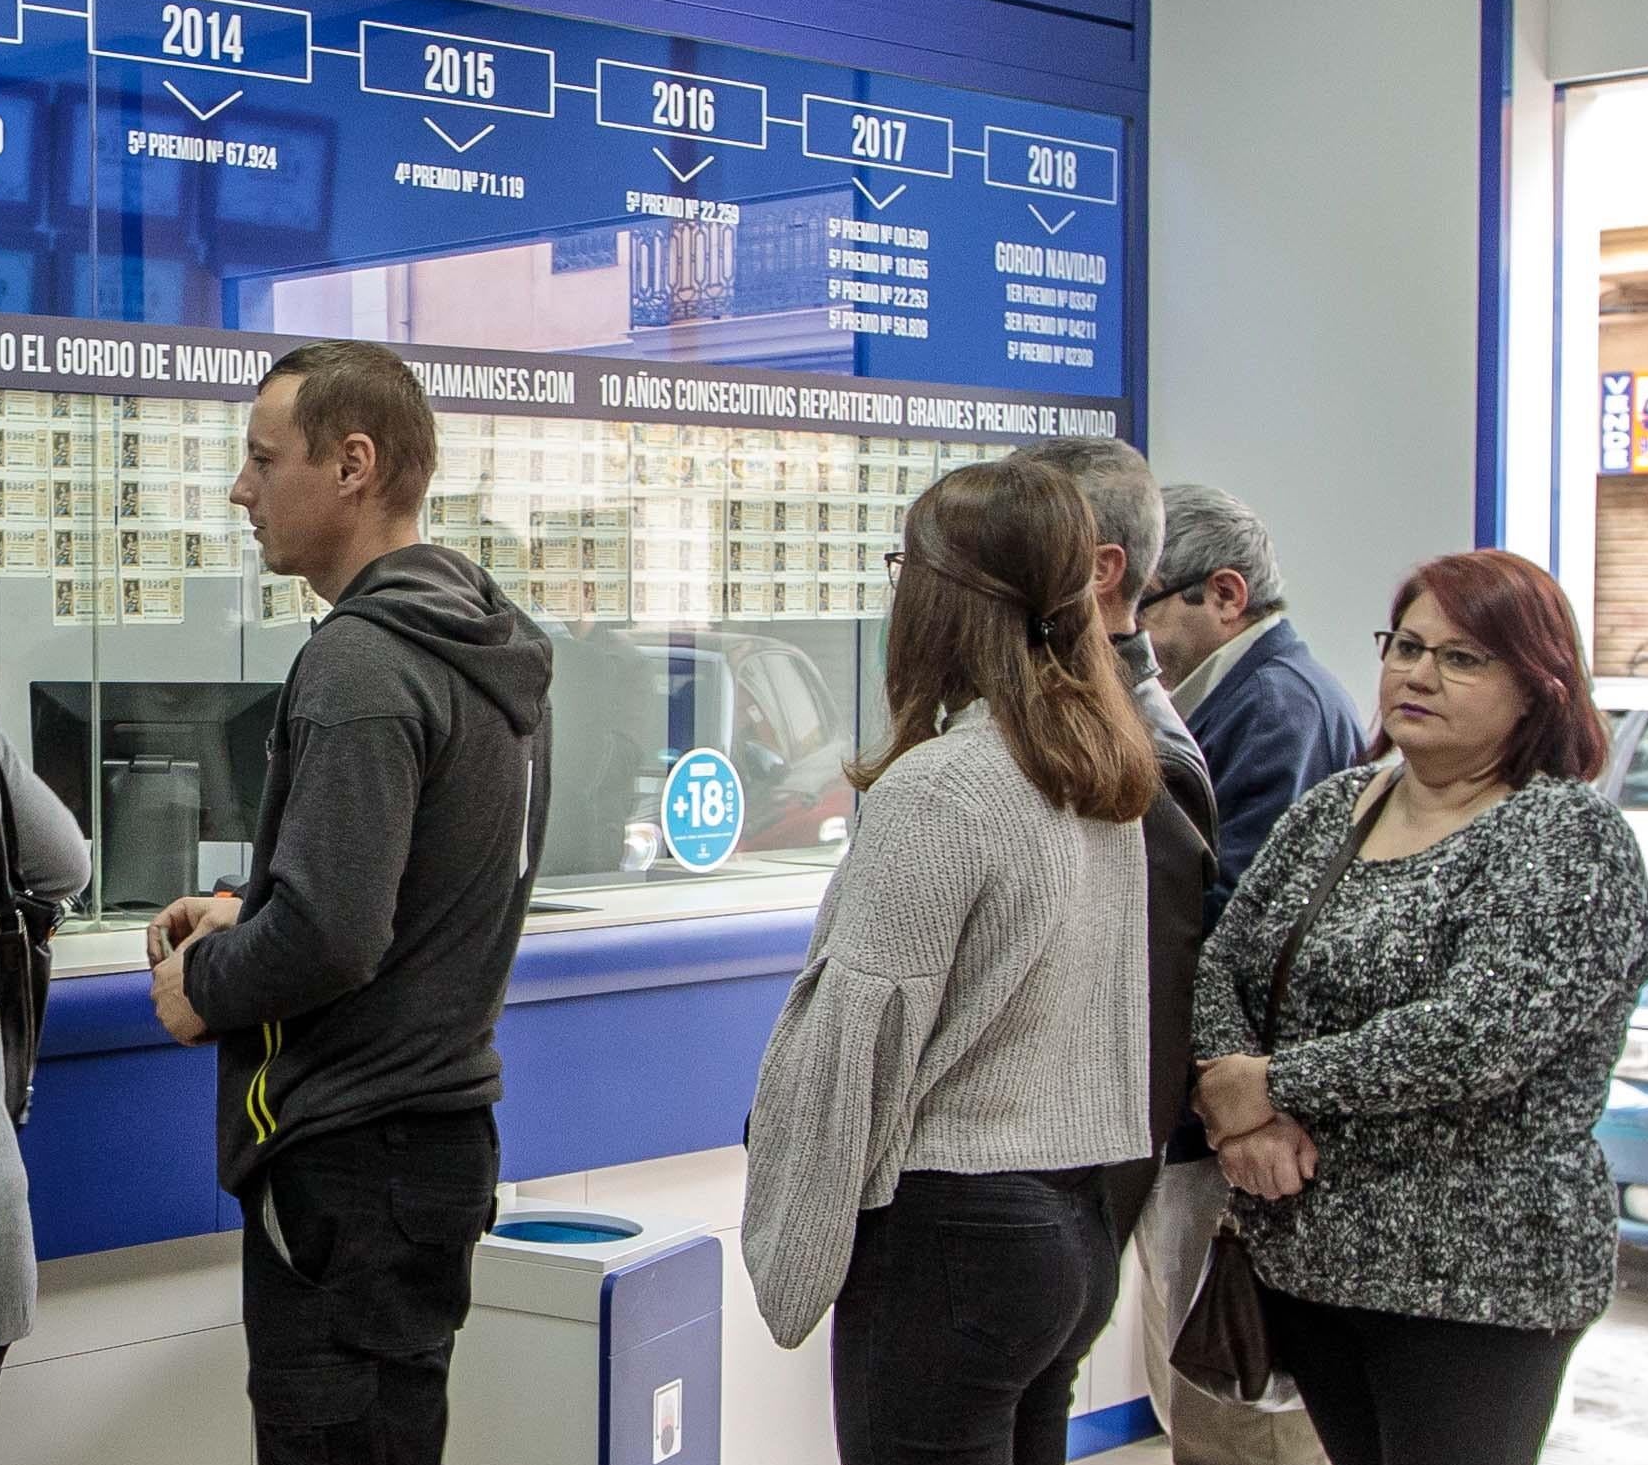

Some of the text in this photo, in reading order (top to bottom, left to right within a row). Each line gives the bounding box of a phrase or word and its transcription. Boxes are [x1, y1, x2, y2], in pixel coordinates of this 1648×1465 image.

[161, 4, 244, 64] 2014
[423, 44, 496, 100] 2015
[651, 80, 716, 133] 2016
[128, 129, 278, 171] 5º PREMIO Nº 67.924
[851, 115, 908, 164] 2017
[394, 162, 412, 186] 4º
[412, 165, 462, 194] PREMIO
[479, 171, 525, 200] 71.119
[1027, 144, 1078, 192] 2018
[994, 240, 1107, 285] GORDO NAVIDAD
[21, 333, 52, 374] EL
[55, 336, 135, 379] GORDO
[139, 341, 170, 382] DE
[175, 344, 274, 387] NAVIDAD
[599, 370, 1117, 438] 10 AÑOS CONSECUTIVOS REPARTIENDO GRANDES PREMIOS DE NAVIDAD
[671, 779, 727, 829] +18
